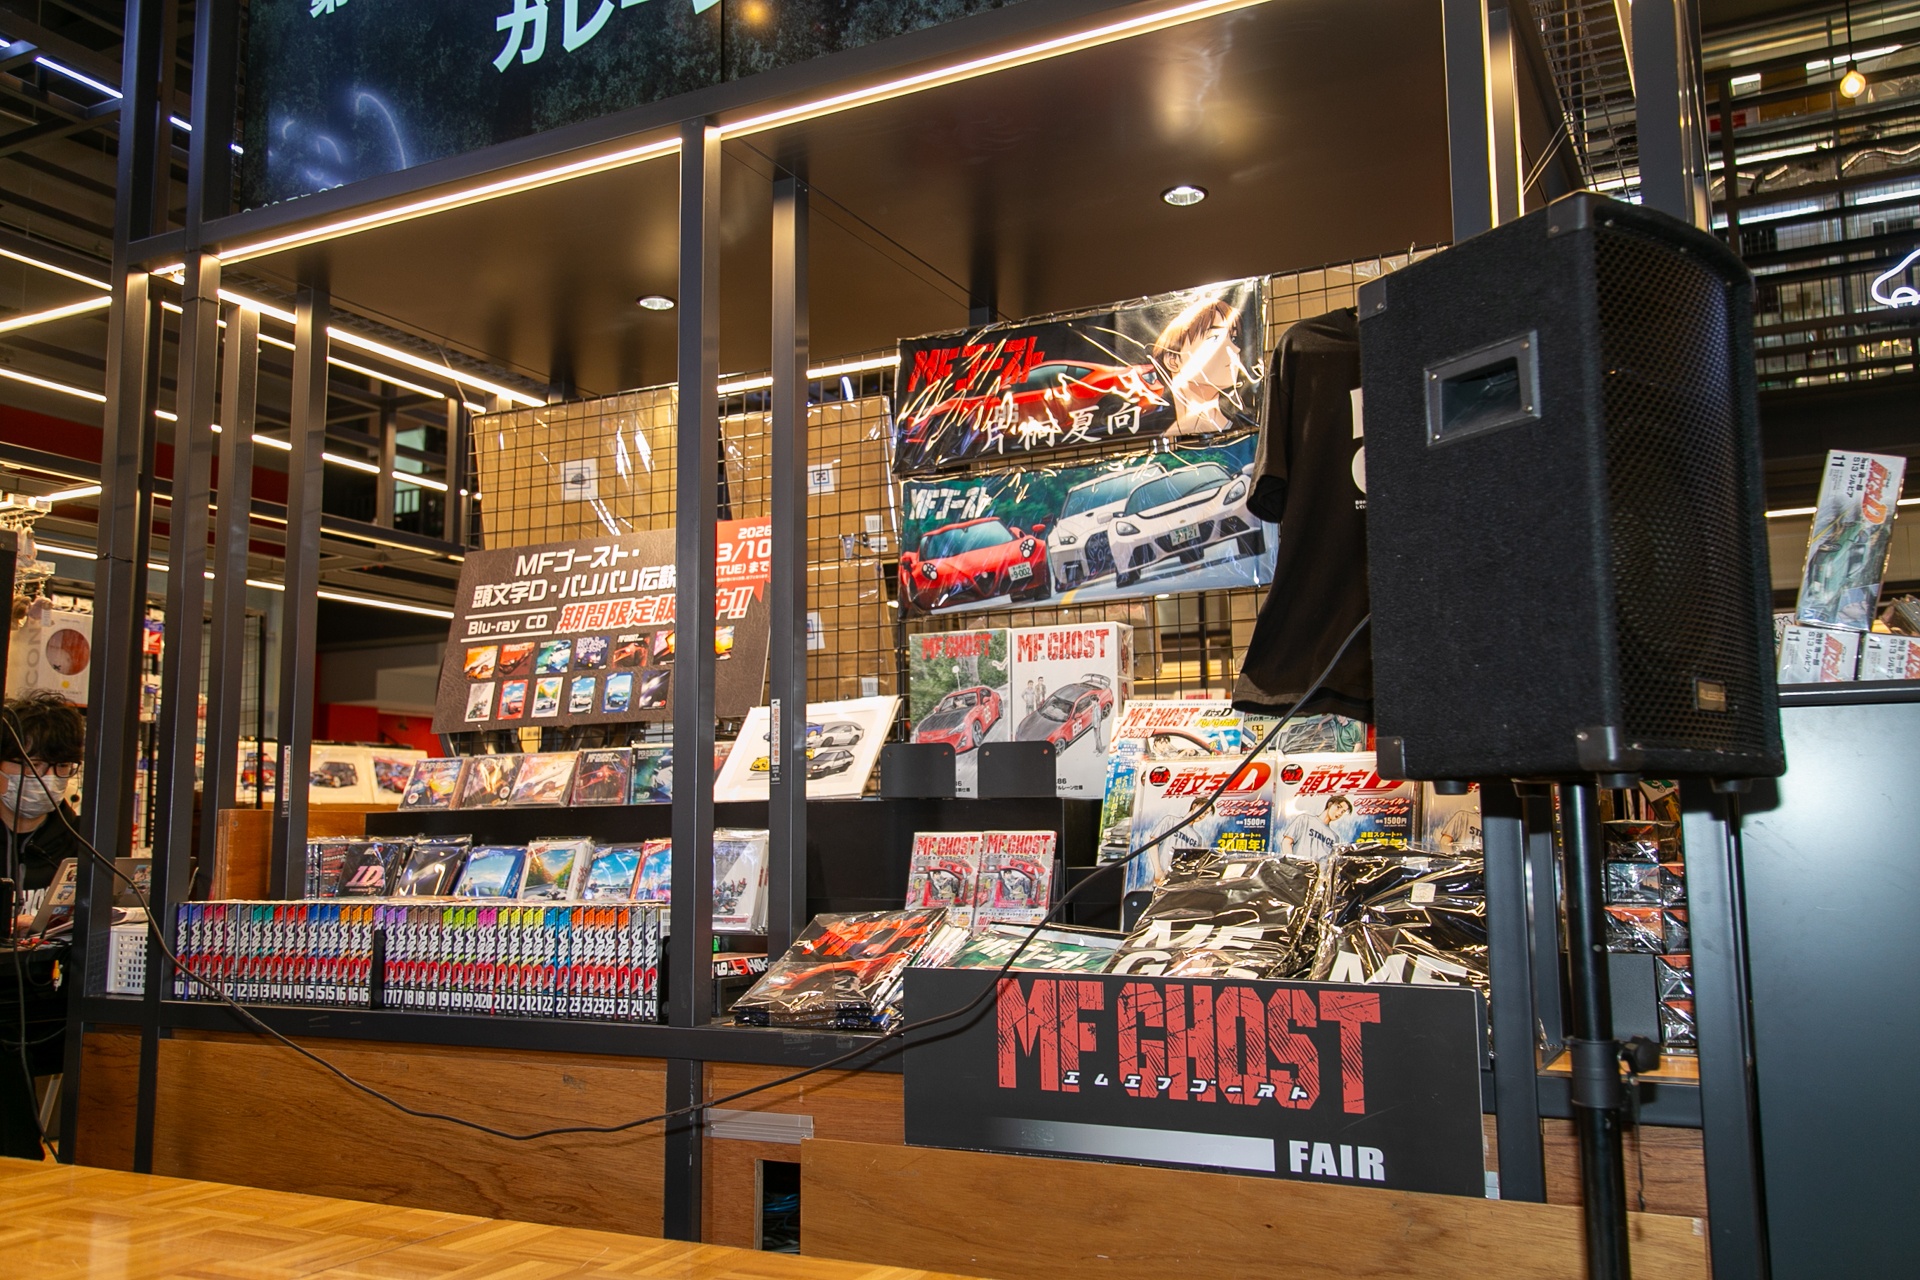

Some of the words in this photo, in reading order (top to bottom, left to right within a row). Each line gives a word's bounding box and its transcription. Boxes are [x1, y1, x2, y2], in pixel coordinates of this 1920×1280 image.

[1832, 455, 1847, 467] 11
[717, 539, 771, 562] 3/10
[749, 561, 769, 573] まで
[468, 618, 520, 635] Blu-ray
[525, 615, 548, 629] CD
[1787, 629, 1800, 642] 11
[945, 633, 992, 658] GHOST
[1017, 632, 1045, 662] MF
[1046, 629, 1109, 660] GHOST
[1145, 707, 1200, 726] GHOST
[1072, 719, 1082, 735] 86
[1244, 818, 1266, 826] 1500円
[1384, 817, 1407, 825] 1500円
[916, 836, 937, 856] MF
[937, 835, 979, 856] GHOST
[986, 834, 1007, 855] MF
[1007, 833, 1051, 855] GHOST
[174, 982, 184, 994] 10
[188, 982, 198, 995] 10
[224, 984, 234, 996] 12
[237, 984, 248, 996] 12
[249, 984, 258, 996] 13
[260, 985, 270, 997] 13
[271, 985, 280, 997] 14
[282, 985, 292, 998] 14
[294, 985, 304, 998] 14
[305, 986, 314, 999] 15
[316, 986, 326, 999] 15
[326, 986, 336, 999] 15
[336, 986, 346, 1000] 16
[348, 987, 358, 1000] 16
[359, 987, 370, 1000] 16
[384, 990, 394, 1003] 17
[393, 990, 402, 1004] 17
[404, 991, 414, 1004] 18
[415, 991, 426, 1005] 18
[426, 991, 436, 1005] 18
[439, 992, 450, 1006] 19
[451, 992, 462, 1007] 19
[463, 993, 472, 1007] 19
[482, 994, 492, 1008] 20
[494, 994, 506, 1009] 21
[507, 995, 518, 1010] 21
[519, 996, 532, 1010] 21
[531, 996, 542, 1011] 21
[542, 996, 554, 1011] 22
[556, 997, 566, 1012] 22
[569, 997, 580, 1013] 23
[582, 998, 592, 1013] 23
[593, 998, 604, 1014] 23
[604, 999, 614, 1014] 23
[617, 999, 628, 1015] 23
[631, 1000, 642, 1015] 24
[645, 1000, 656, 1016] 24
[997, 978, 1105, 1092] MF
[1117, 982, 1381, 1115] GHOST
[1288, 1139, 1386, 1182] FAIR
